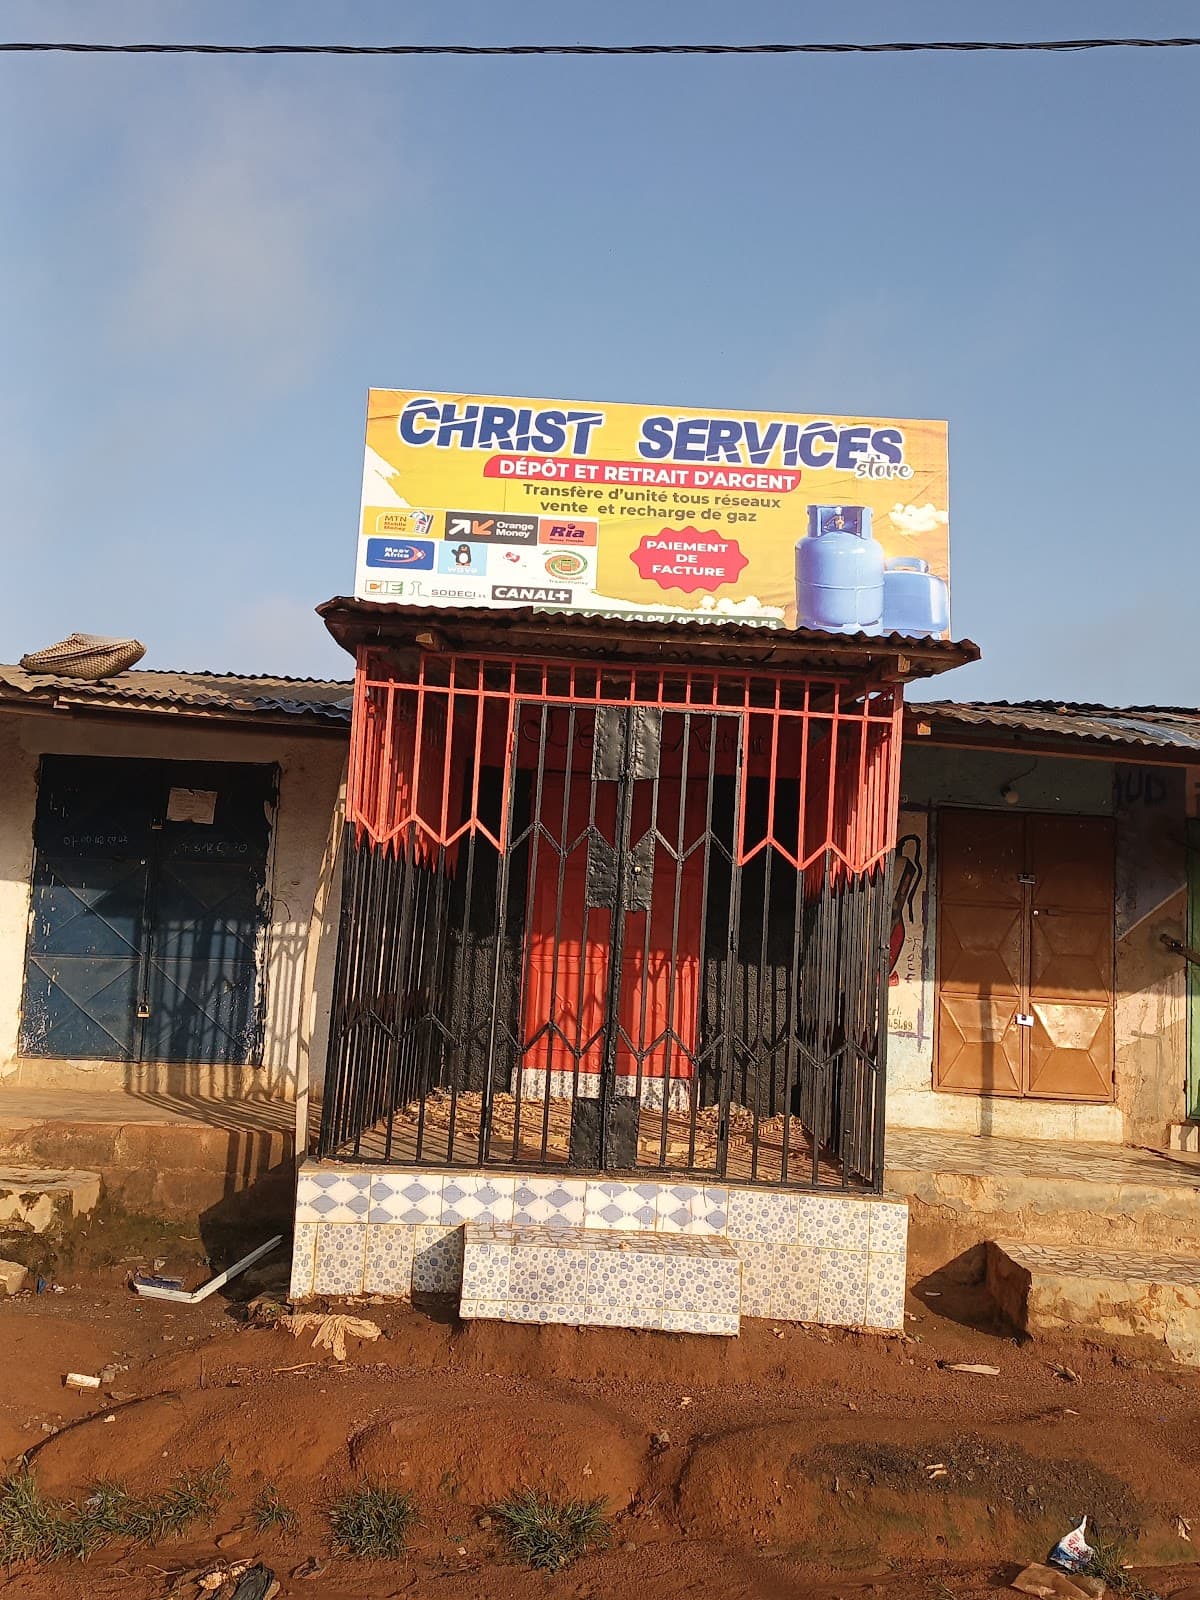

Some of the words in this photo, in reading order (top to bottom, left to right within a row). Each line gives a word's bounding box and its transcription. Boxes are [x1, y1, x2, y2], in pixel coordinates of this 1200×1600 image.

[399, 399, 604, 455] CHRIST
[638, 416, 903, 468] SERVICES
[499, 457, 569, 478] DÉPÔT
[574, 464, 599, 480] ET
[604, 466, 689, 485] RETRAIT
[694, 471, 796, 490] D'ARGENT
[856, 457, 912, 478] store
[523, 483, 604, 499] Transfère
[608, 488, 668, 503] d'unité
[672, 492, 710, 505] tous
[714, 494, 781, 508] réseaux
[540, 501, 588, 513] vente
[597, 503, 615, 515] et
[620, 505, 696, 521] recharge
[700, 508, 722, 520] de
[726, 511, 757, 524] gaz
[496, 521, 535, 531] Orange
[549, 524, 585, 539] Ria
[496, 529, 530, 539] Money
[646, 541, 729, 553] PAIEMENT
[675, 554, 698, 564] DE
[652, 565, 726, 577] FACTURE
[431, 589, 476, 598] SODECI
[494, 586, 570, 602] CANAL+
